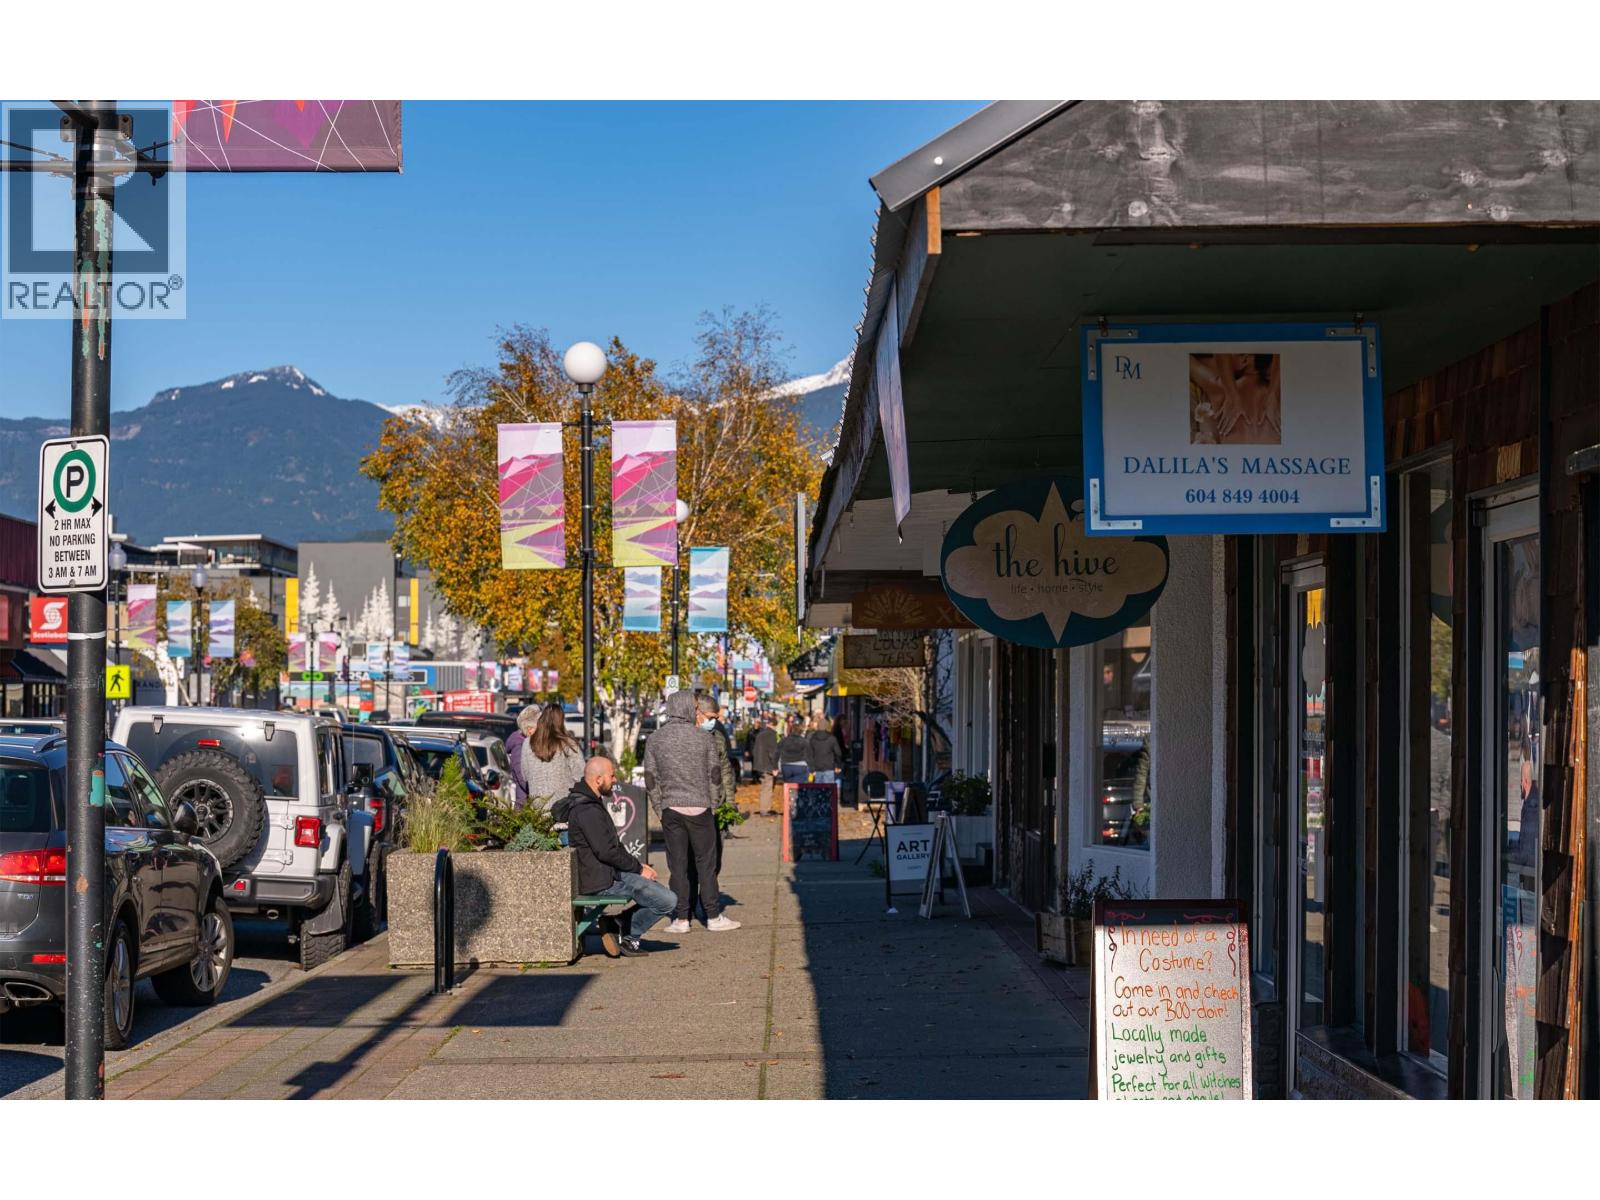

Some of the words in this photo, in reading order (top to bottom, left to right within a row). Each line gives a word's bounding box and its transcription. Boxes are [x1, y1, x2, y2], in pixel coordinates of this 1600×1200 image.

[1123, 456, 1228, 475] DALILA'S
[1241, 456, 1351, 475] MASSAGE
[1185, 488, 1216, 504] 604
[1222, 488, 1252, 504] 849
[1258, 488, 1300, 504] 4004
[54, 519, 59, 531] 2
[61, 519, 72, 530] HR
[74, 517, 91, 529] MAX
[49, 535, 60, 547] NO
[62, 533, 96, 546] PARKING
[54, 549, 91, 562] BETWEEN
[992, 523, 1043, 577] the
[1054, 522, 1120, 577] hive
[48, 567, 54, 578] 3
[55, 566, 67, 578] AM
[70, 566, 75, 577] &
[78, 566, 82, 576] 7
[84, 565, 97, 576] AM
[1010, 583, 1027, 594] life
[1038, 583, 1068, 593] home
[1078, 582, 1104, 594] style
[879, 653, 914, 665] TEAS
[896, 840, 930, 853] ART
[896, 853, 930, 861] GALLERY
[1120, 922, 1136, 945] In
[1140, 920, 1179, 947] need
[1184, 922, 1200, 943] of
[1204, 930, 1217, 942] a
[1139, 948, 1213, 972] Costume?
[1114, 975, 1153, 999] Come
[1157, 981, 1171, 998] in
[1176, 981, 1200, 1000] and
[1113, 1003, 1134, 1017] out
[1138, 1006, 1160, 1017] our
[1111, 1022, 1165, 1053] Locally
[1169, 1024, 1207, 1043] made
[1111, 1047, 1168, 1077] jewelry
[1169, 1050, 1191, 1064] and
[1195, 1046, 1227, 1069] gifts
[1112, 1073, 1157, 1093] Perfect
[1162, 1075, 1180, 1091] for
[1182, 1071, 1198, 1090] all
